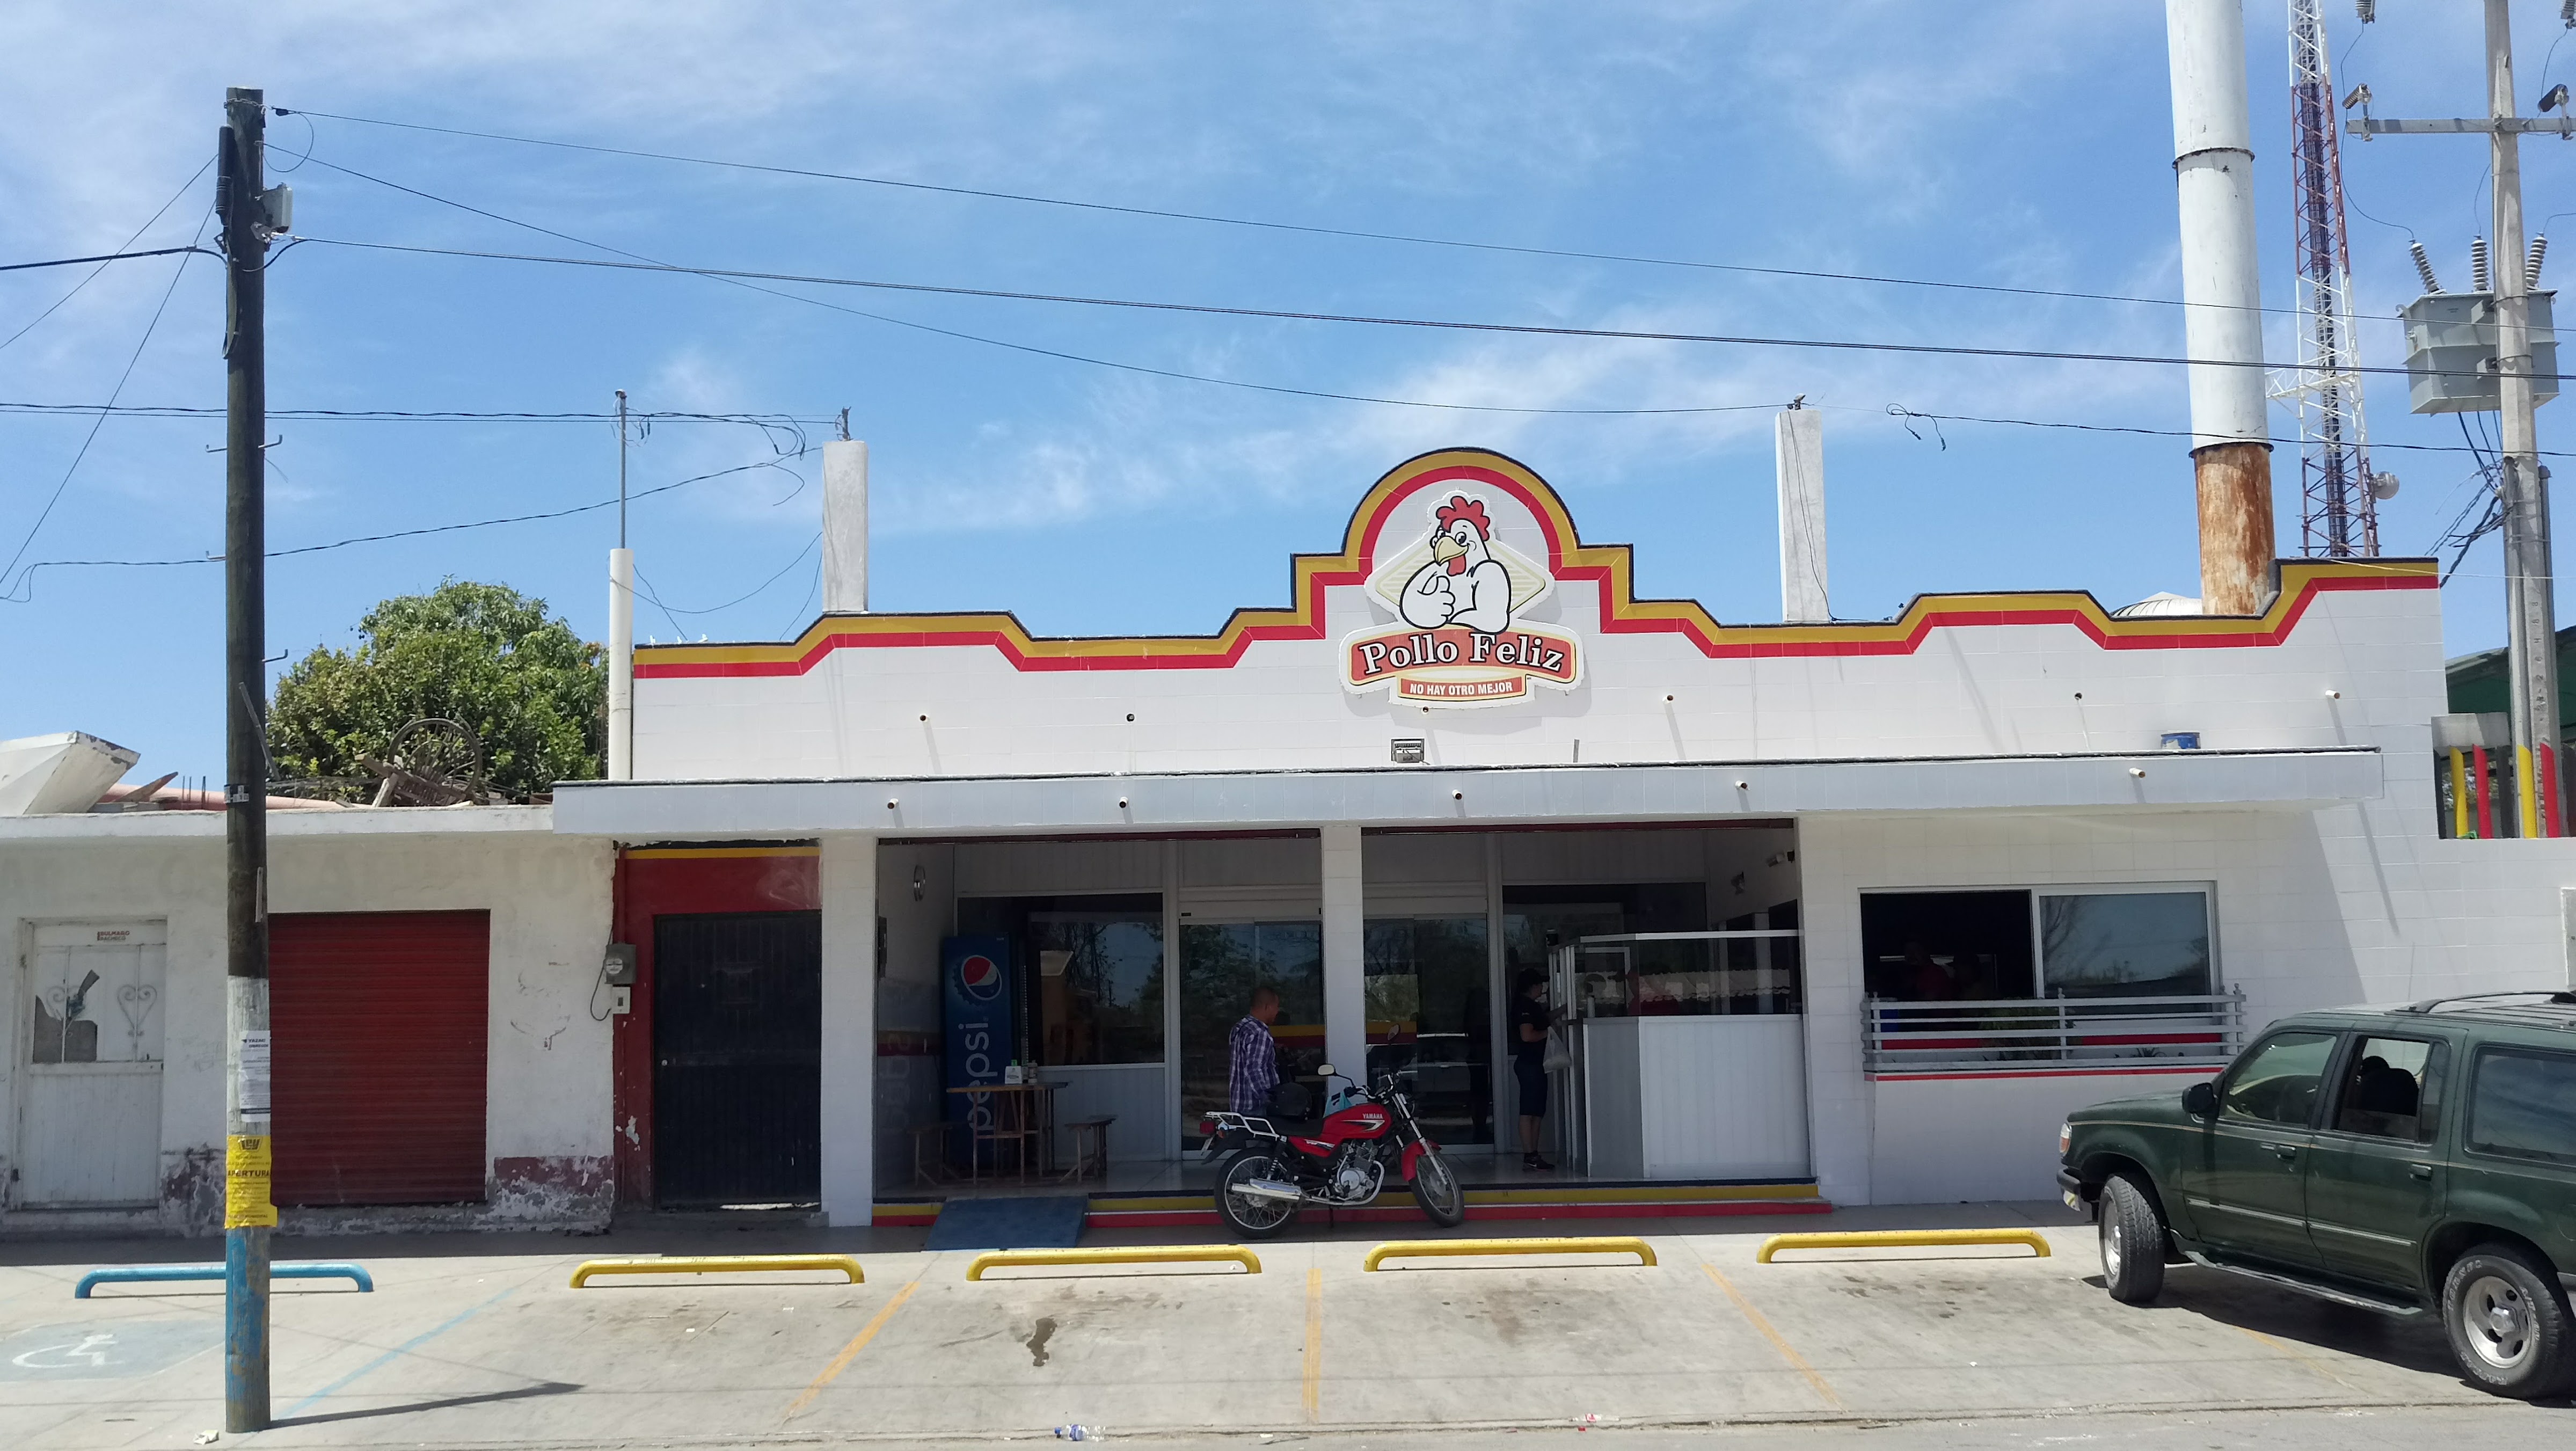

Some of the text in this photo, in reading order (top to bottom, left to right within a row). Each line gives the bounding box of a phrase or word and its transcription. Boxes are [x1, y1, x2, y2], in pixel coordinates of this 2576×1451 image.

[1359, 632, 1564, 675] Pollo Feliz
[1410, 682, 1513, 695] NO HAY OTRO MEJOR
